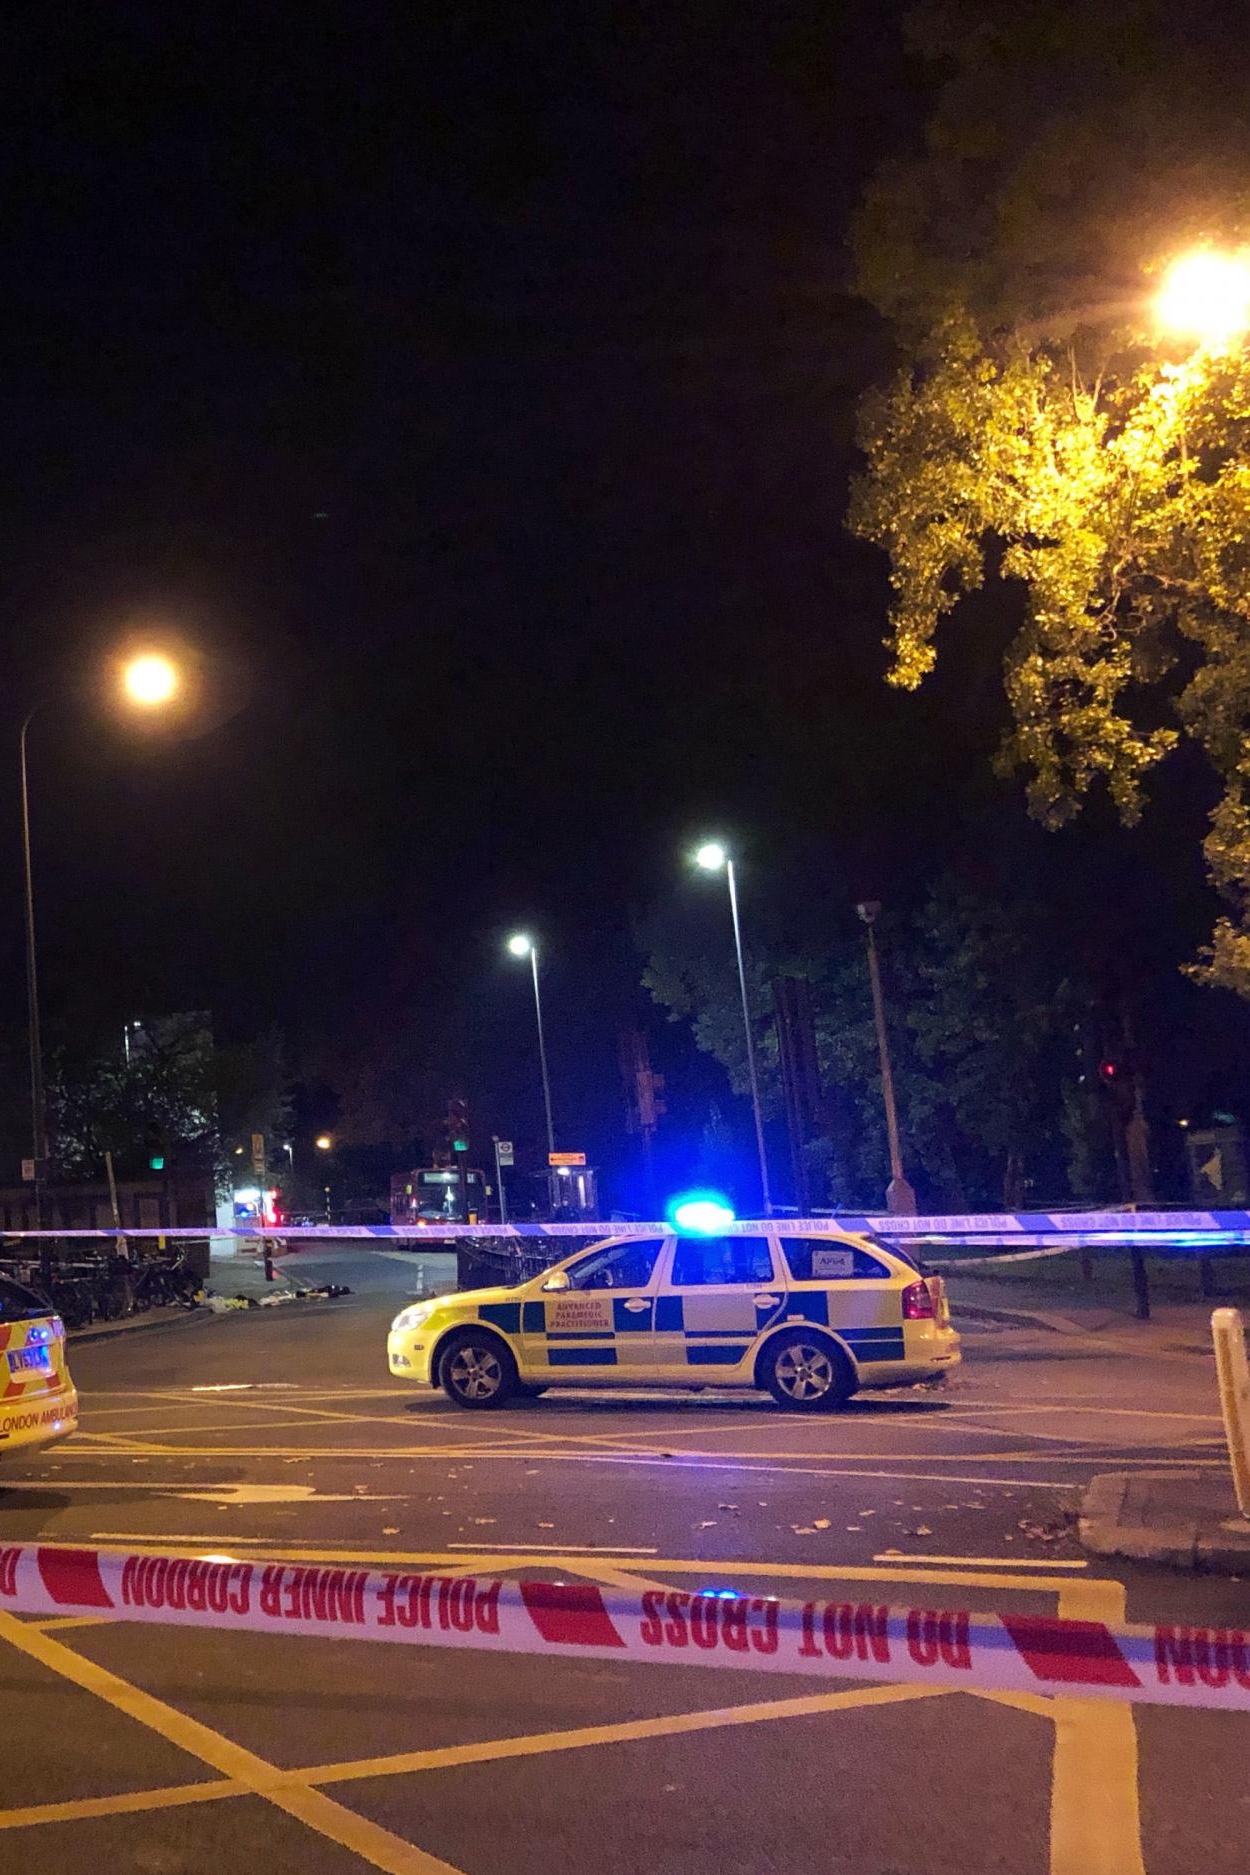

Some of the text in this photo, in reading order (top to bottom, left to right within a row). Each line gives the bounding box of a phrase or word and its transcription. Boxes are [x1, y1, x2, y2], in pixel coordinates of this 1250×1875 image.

[742, 1224, 759, 1233] NOT
[761, 1223, 774, 1232] DO
[776, 1222, 795, 1232] LINE
[798, 1221, 829, 1231] POLICE
[121, 1555, 503, 1635] POLICE INNER CORDON
[639, 1591, 972, 1670] DO NOT CROSS
